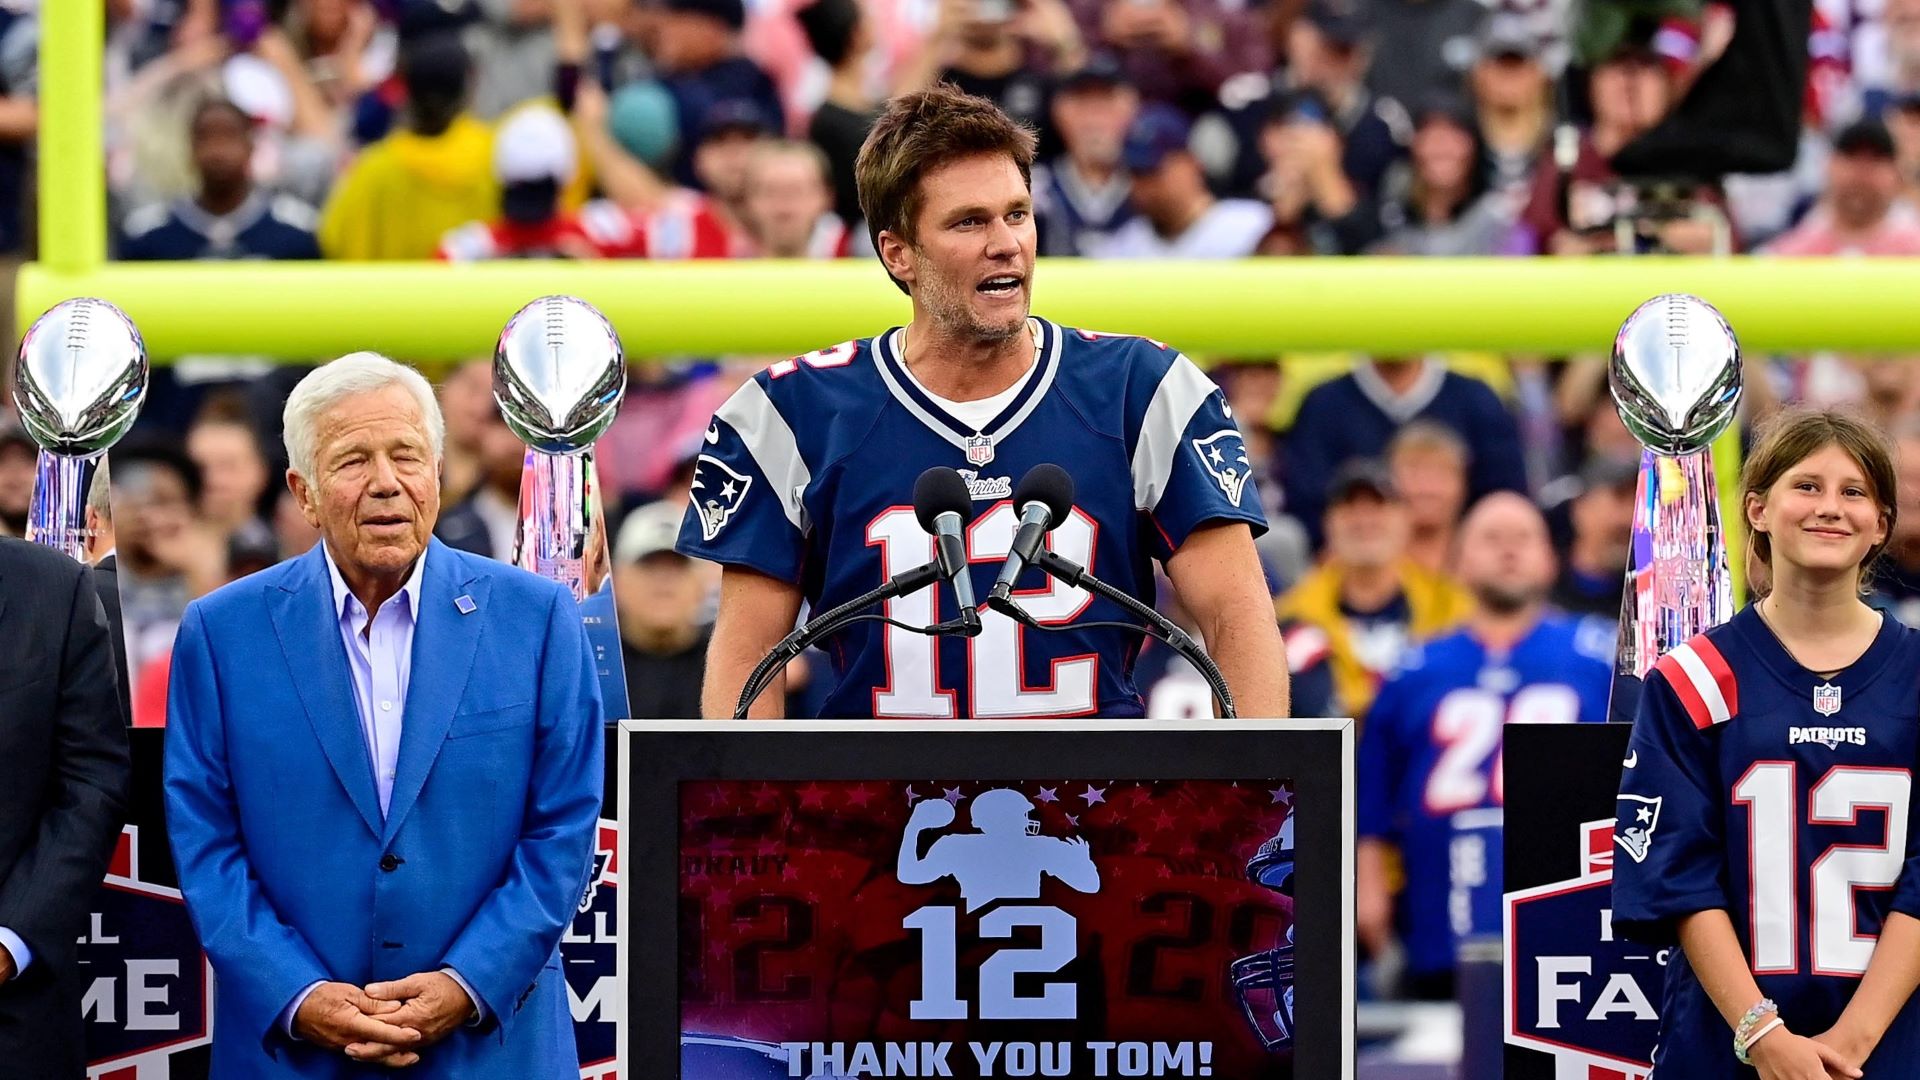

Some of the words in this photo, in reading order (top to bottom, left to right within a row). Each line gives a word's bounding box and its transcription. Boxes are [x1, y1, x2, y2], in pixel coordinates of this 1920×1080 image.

[971, 446, 991, 460] NFL
[865, 498, 1099, 719] 12
[1789, 726, 1866, 746] PATRIOTS
[1818, 698, 1837, 709] NFL
[1731, 759, 1911, 977] 12
[81, 959, 180, 1030] ME
[902, 905, 1077, 1020] 12
[1535, 956, 1659, 1028] FA
[781, 1041, 953, 1077] THANK
[968, 1041, 1072, 1077] YOU
[1086, 1041, 1213, 1077] TOM!
